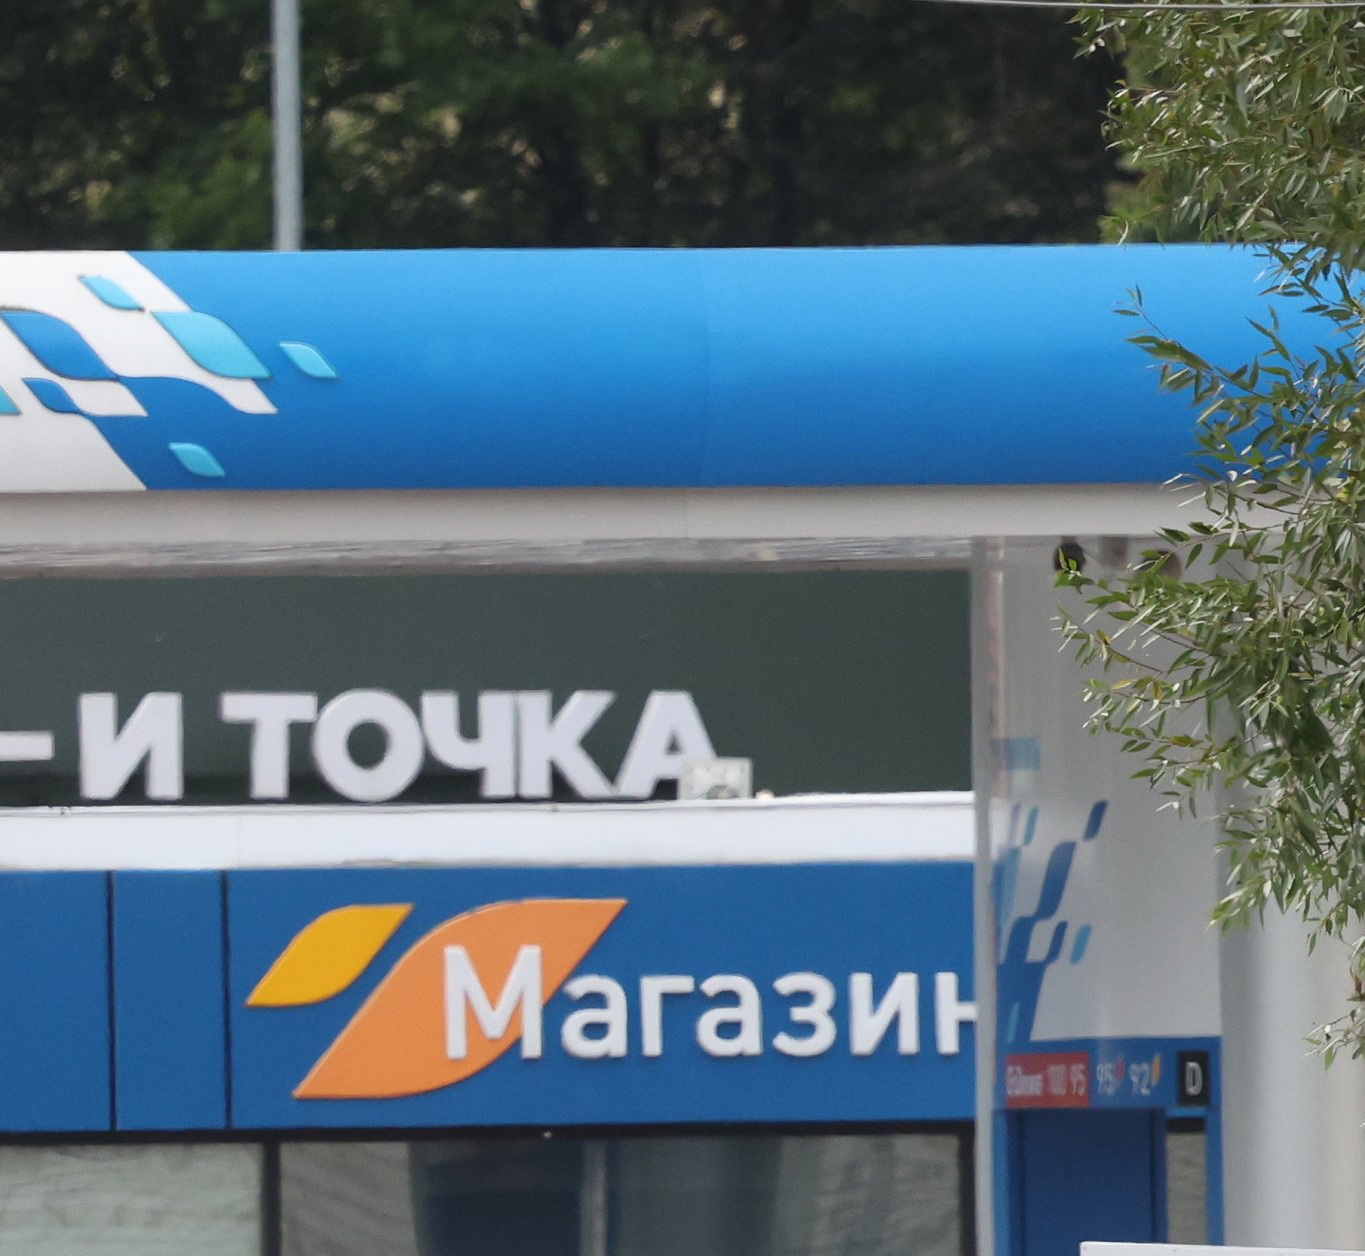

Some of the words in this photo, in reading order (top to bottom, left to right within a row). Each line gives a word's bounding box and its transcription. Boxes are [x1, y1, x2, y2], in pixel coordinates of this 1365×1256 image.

[79, 692, 184, 802] И
[221, 688, 717, 803] ТОЧКА
[1185, 1061, 1204, 1096] D
